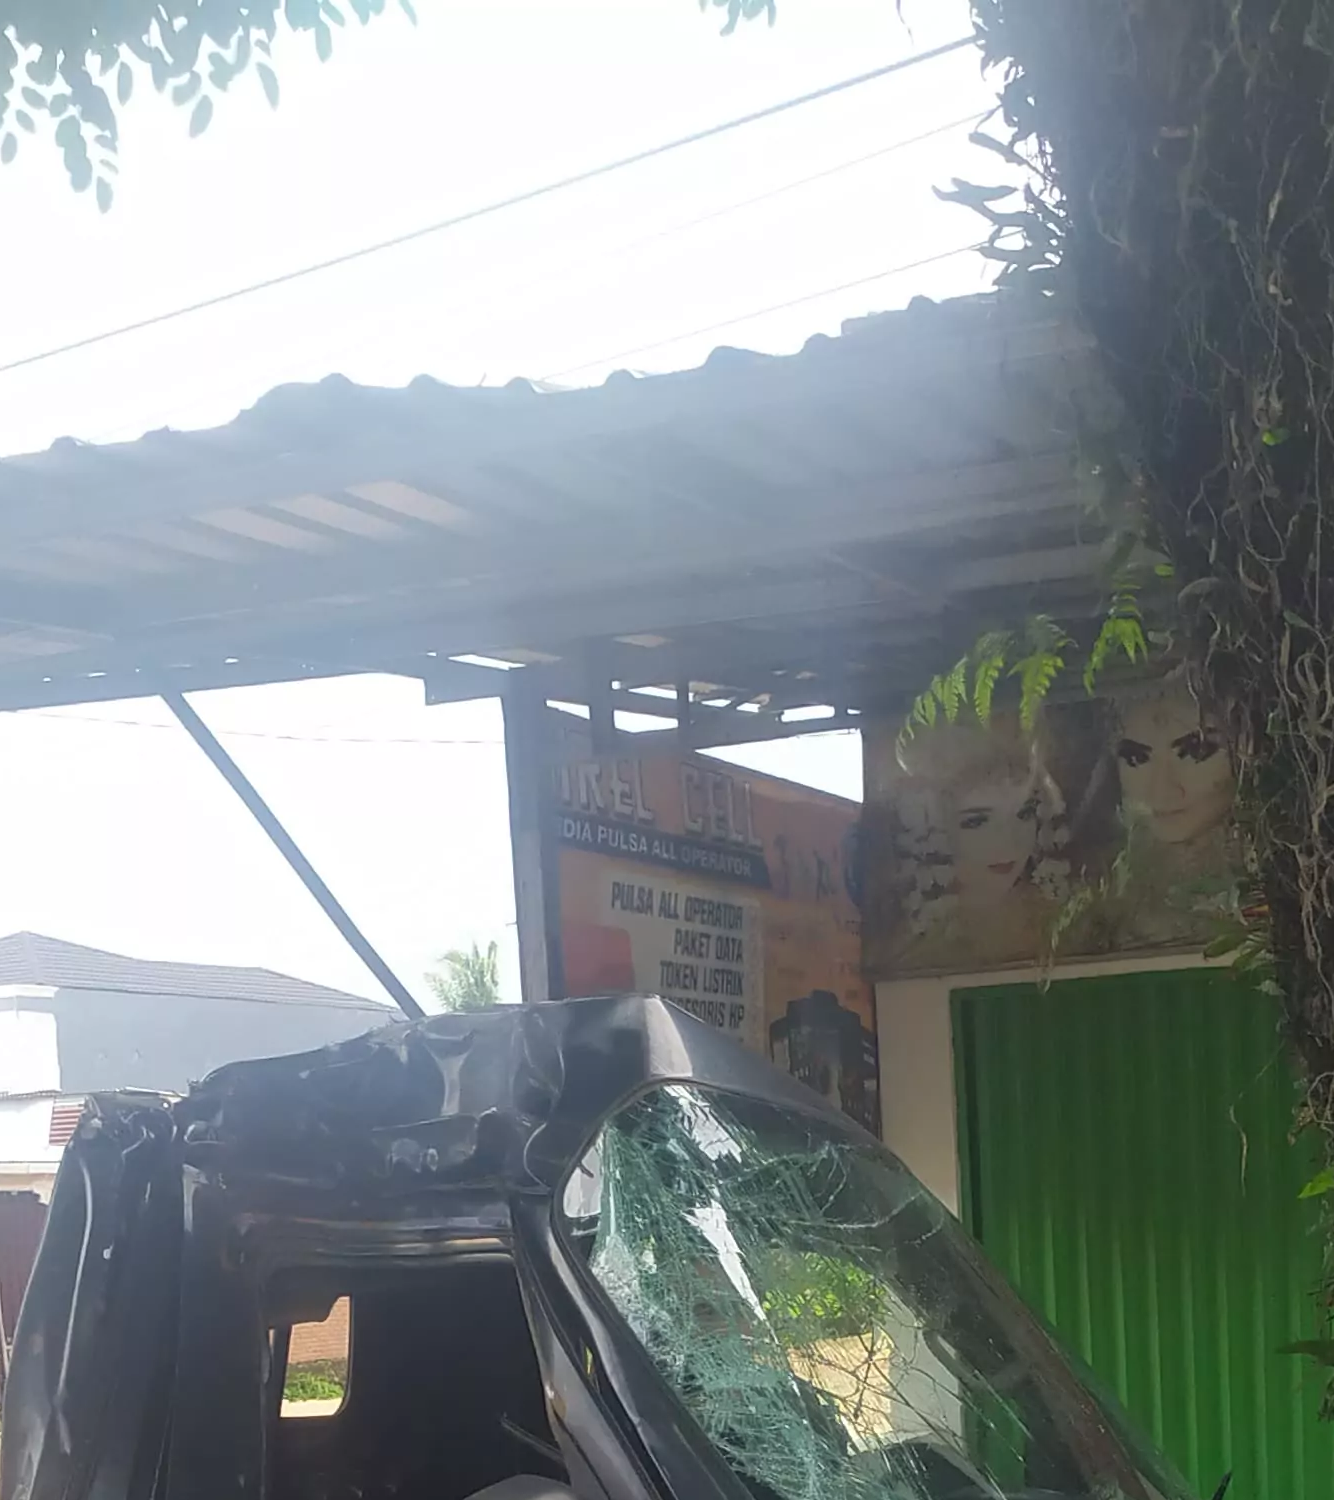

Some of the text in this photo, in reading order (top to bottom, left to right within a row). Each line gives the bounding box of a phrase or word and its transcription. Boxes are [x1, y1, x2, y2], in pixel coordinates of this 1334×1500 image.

[596, 824, 648, 853] PULSA
[651, 839, 679, 862] ALL
[680, 844, 754, 878] OPERATOR
[611, 881, 744, 931] PULSA ALL OPERATOR
[673, 928, 744, 963] PAKET DATA
[659, 960, 745, 997] TOKEN LISTRIK
[728, 1005, 745, 1030] HP
